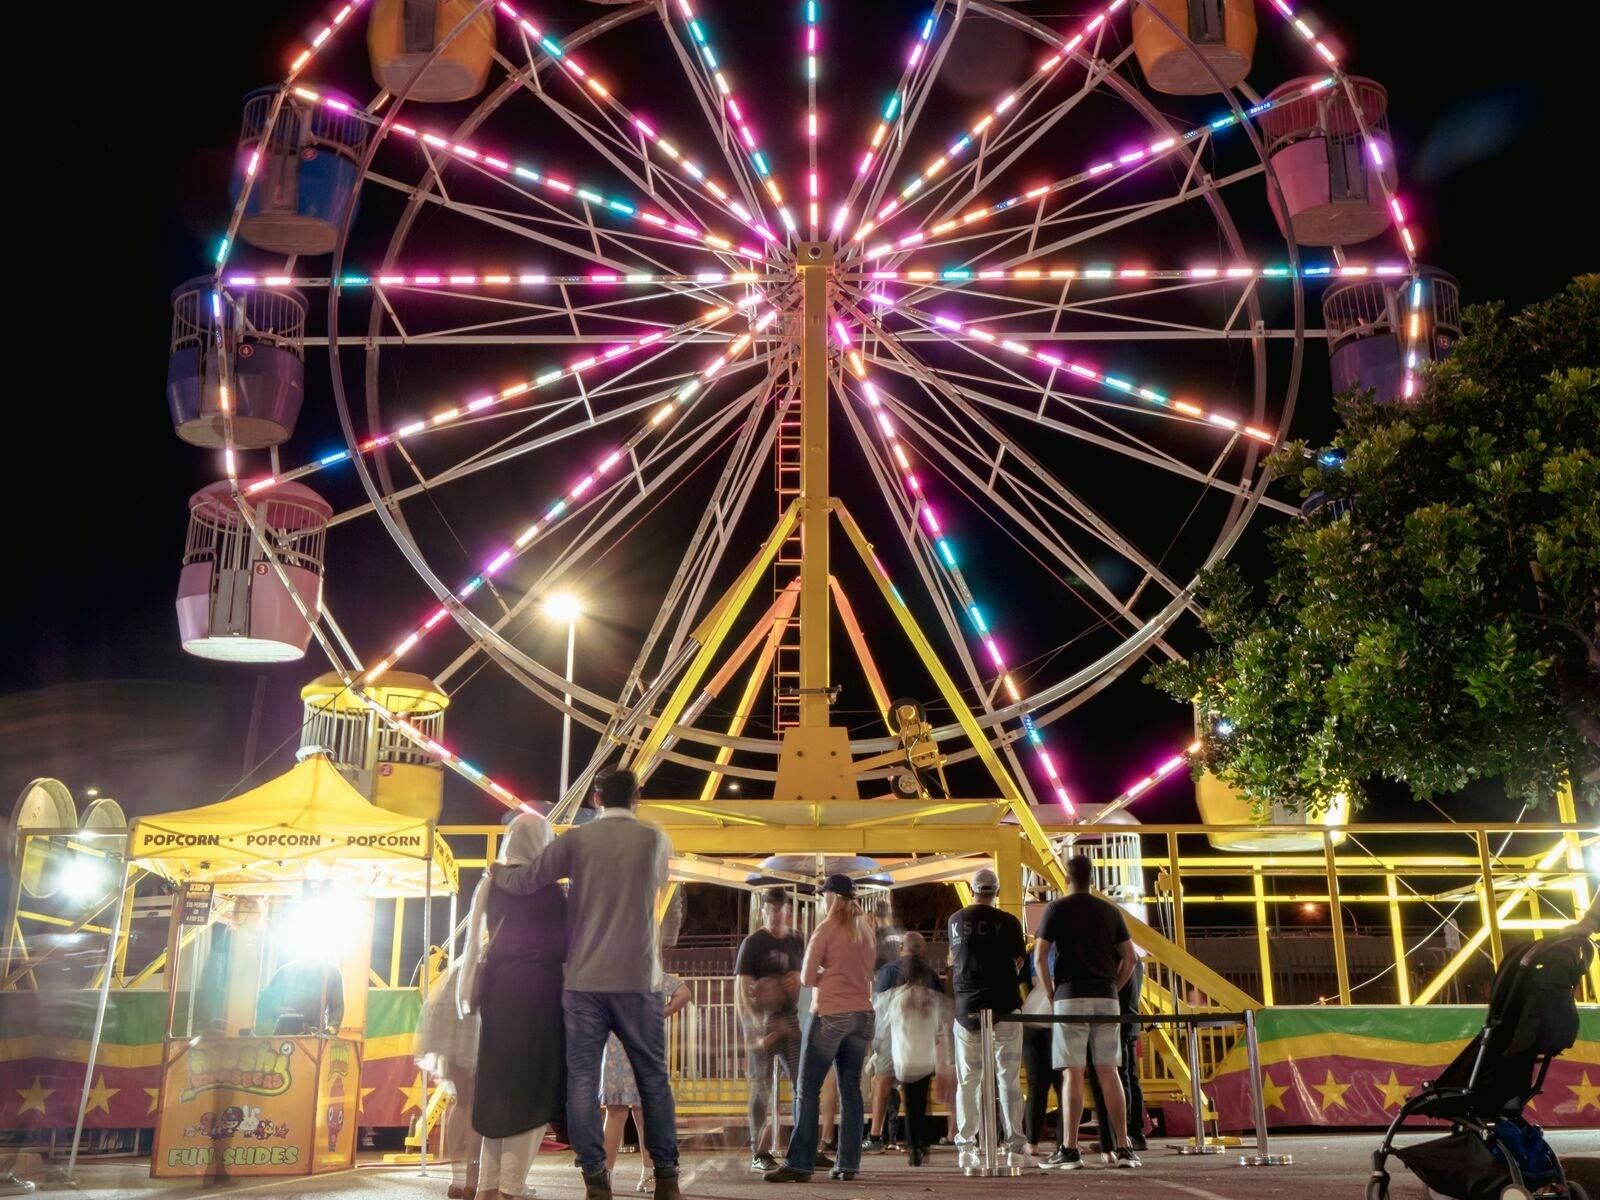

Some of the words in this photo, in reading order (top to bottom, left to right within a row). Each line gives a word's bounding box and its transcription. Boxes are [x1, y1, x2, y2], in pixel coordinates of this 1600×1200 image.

[258, 565, 266, 574] 3
[144, 834, 219, 846] POPCORN
[246, 834, 321, 847] POPCORN
[347, 835, 421, 847] POPCORN
[168, 1147, 214, 1167] FUN
[222, 1146, 299, 1166] SLIDES
